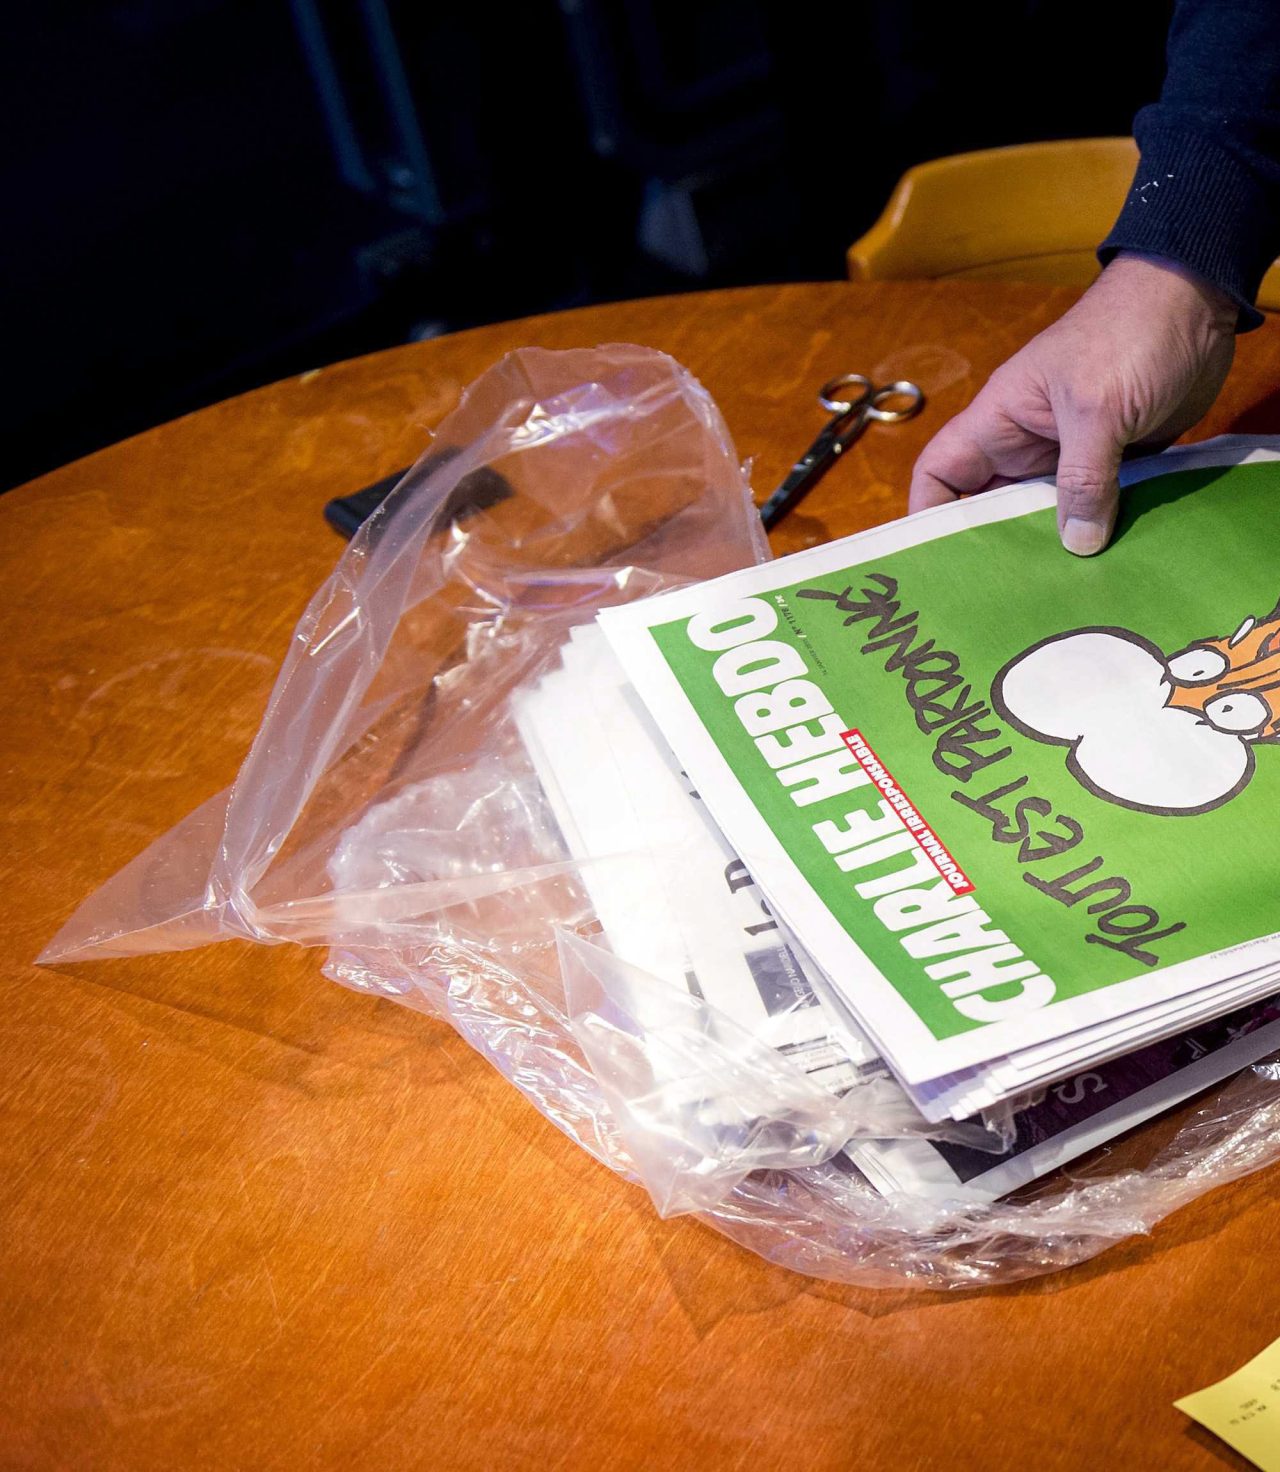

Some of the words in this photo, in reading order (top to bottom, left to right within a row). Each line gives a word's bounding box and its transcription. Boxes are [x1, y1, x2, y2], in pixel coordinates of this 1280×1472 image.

[687, 597, 872, 807] HEBDO
[846, 733, 926, 832] IRRESPONSABLE
[950, 775, 1083, 863] EST
[812, 799, 1056, 1023] CHARLIE
[916, 829, 970, 889] JOURNAL
[1022, 856, 1187, 967] TOUT
